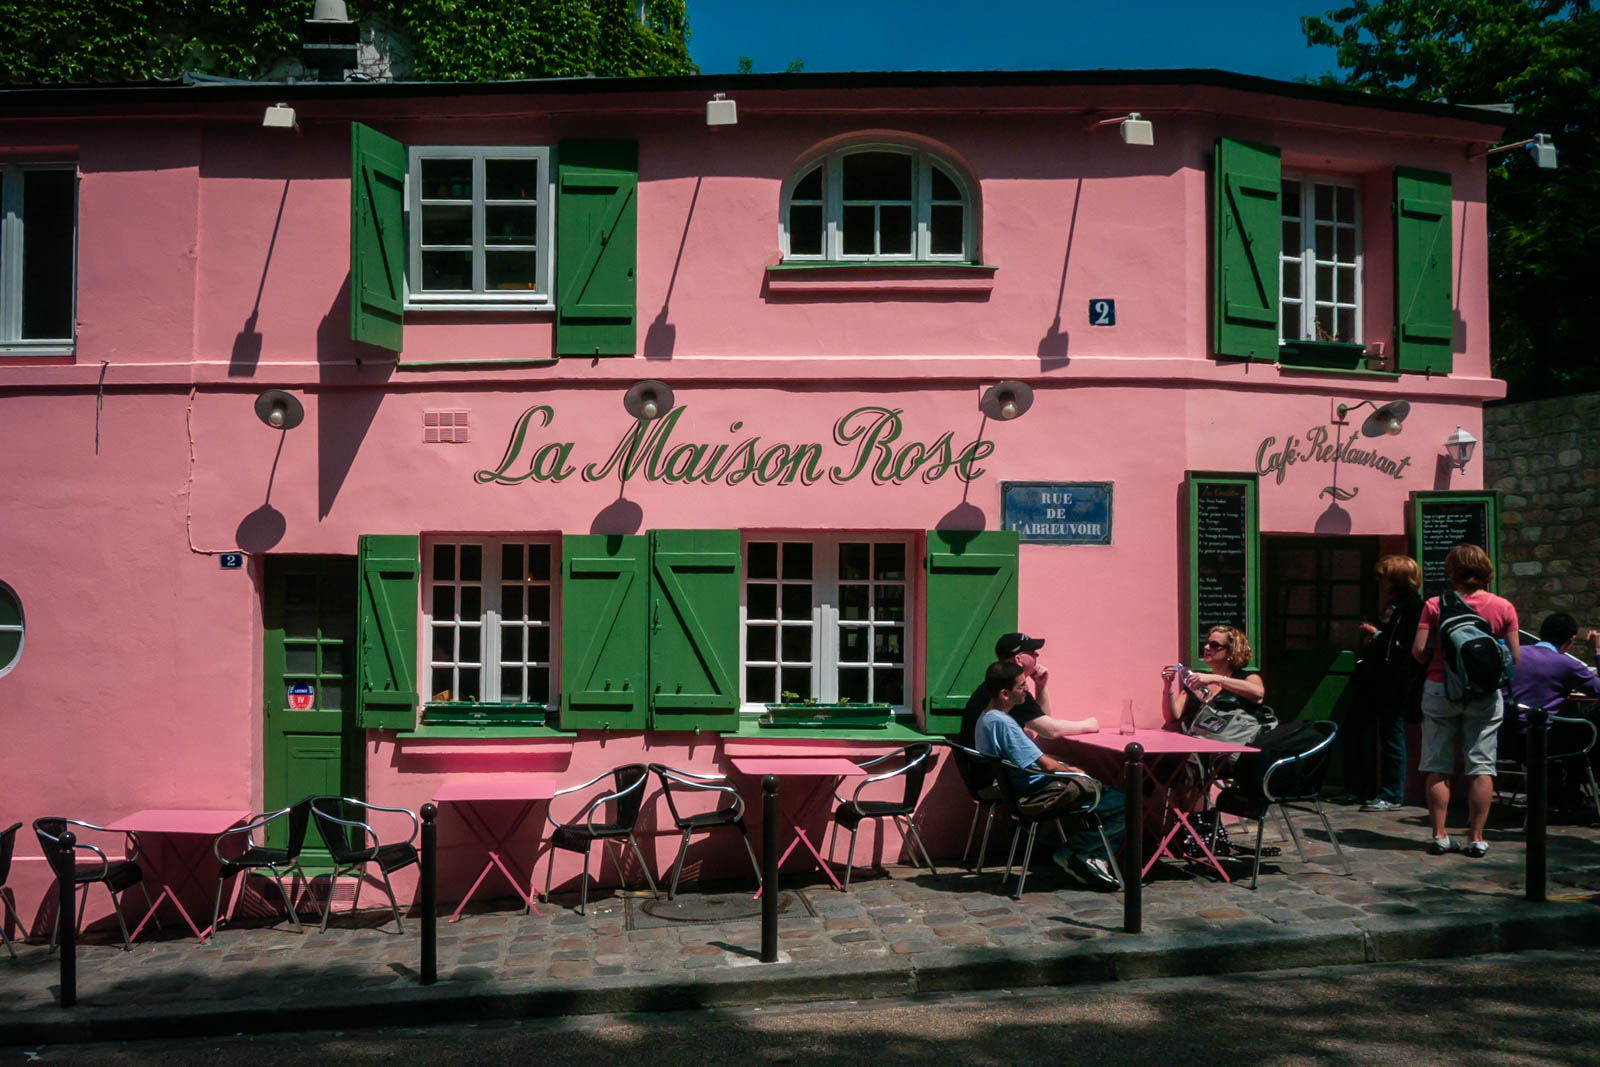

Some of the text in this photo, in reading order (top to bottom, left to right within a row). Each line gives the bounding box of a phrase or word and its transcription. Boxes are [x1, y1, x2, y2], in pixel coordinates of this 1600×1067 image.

[1095, 301, 1109, 324] 2
[473, 405, 995, 486] La Maison Rose
[1300, 425, 1411, 479] Restaurant
[1041, 493, 1073, 505] RUE
[1046, 508, 1066, 519] DE
[1012, 520, 1102, 535] L'ABREUVOIR
[227, 555, 236, 566] 2
